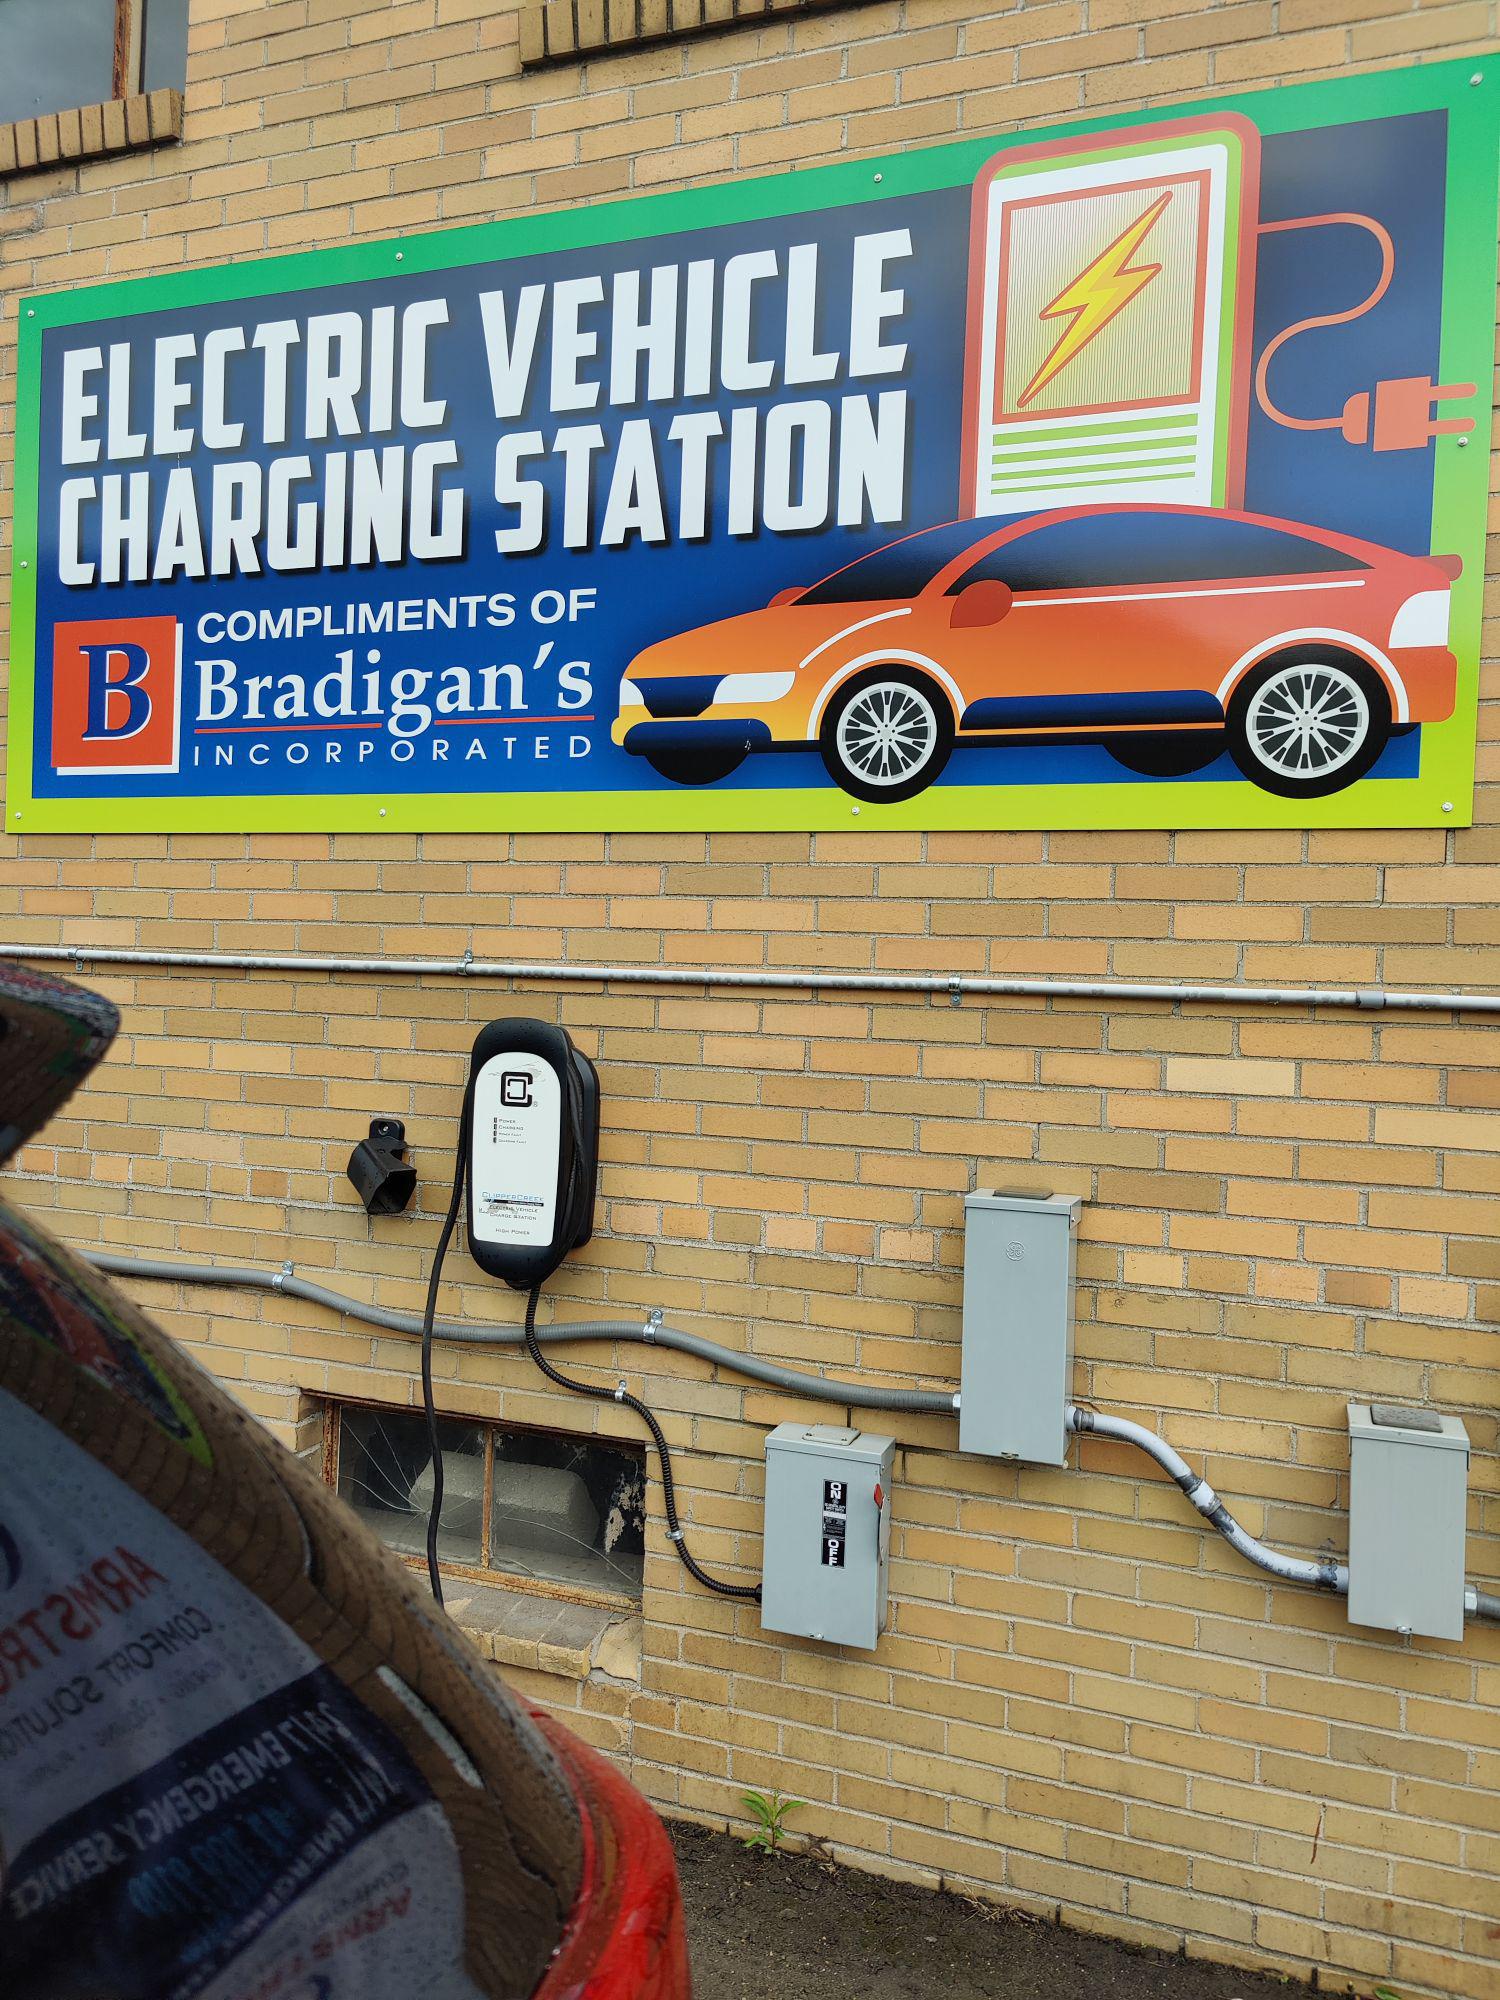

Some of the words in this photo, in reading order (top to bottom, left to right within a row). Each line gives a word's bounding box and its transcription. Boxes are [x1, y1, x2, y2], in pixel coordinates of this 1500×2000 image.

[60, 298, 451, 466] ELECTRIC
[478, 228, 913, 419] VEHICLE
[58, 439, 466, 586] CHARGING
[494, 389, 908, 554] STATION
[197, 592, 517, 644] COMPLIMENTS
[530, 587, 598, 625] OF
[79, 643, 153, 742] B
[194, 640, 595, 738] Bradigan's
[193, 735, 592, 767] INCORPORATED
[830, 1482, 842, 1499] ON
[828, 1539, 840, 1566] OFF
